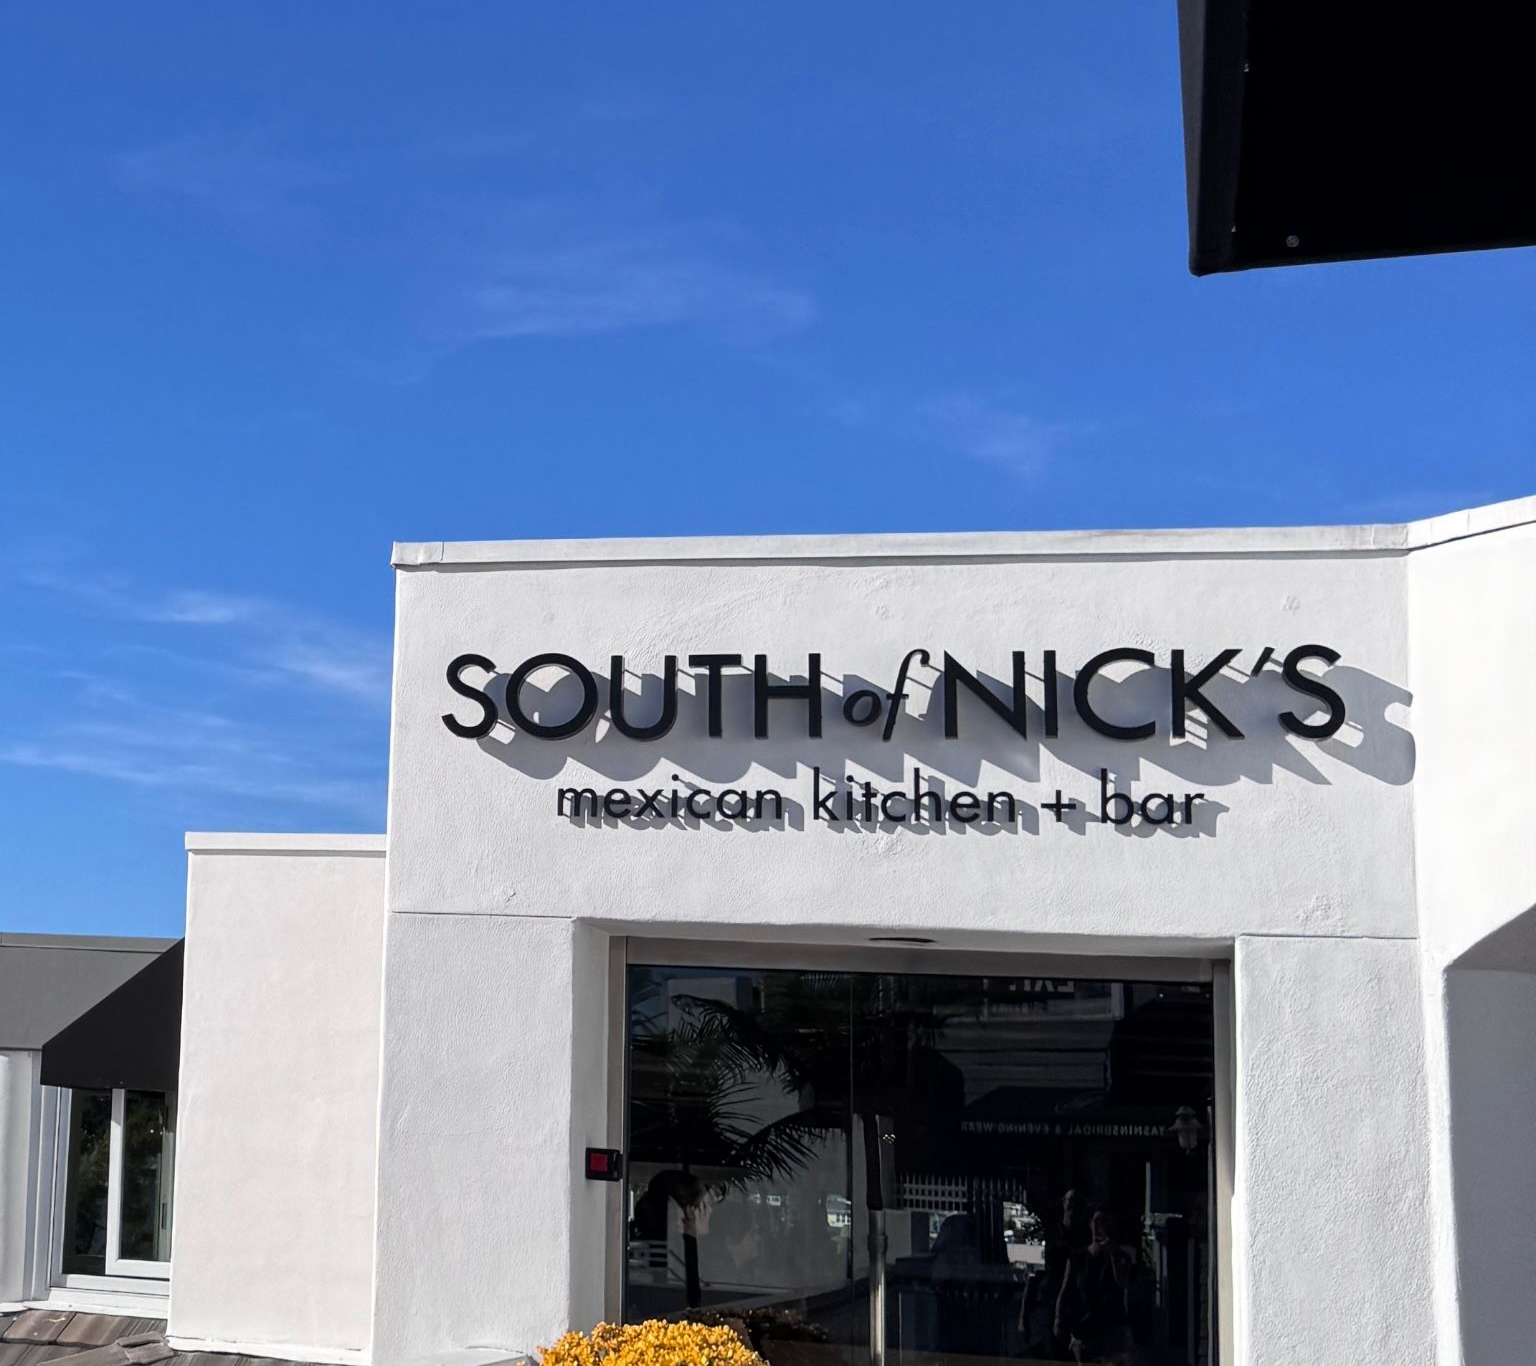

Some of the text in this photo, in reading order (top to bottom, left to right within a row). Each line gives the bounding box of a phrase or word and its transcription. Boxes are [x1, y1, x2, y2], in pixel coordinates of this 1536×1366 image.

[440, 643, 1348, 743] SOUTH of NICK'S
[556, 765, 1206, 827] mexican kitchen + bar
